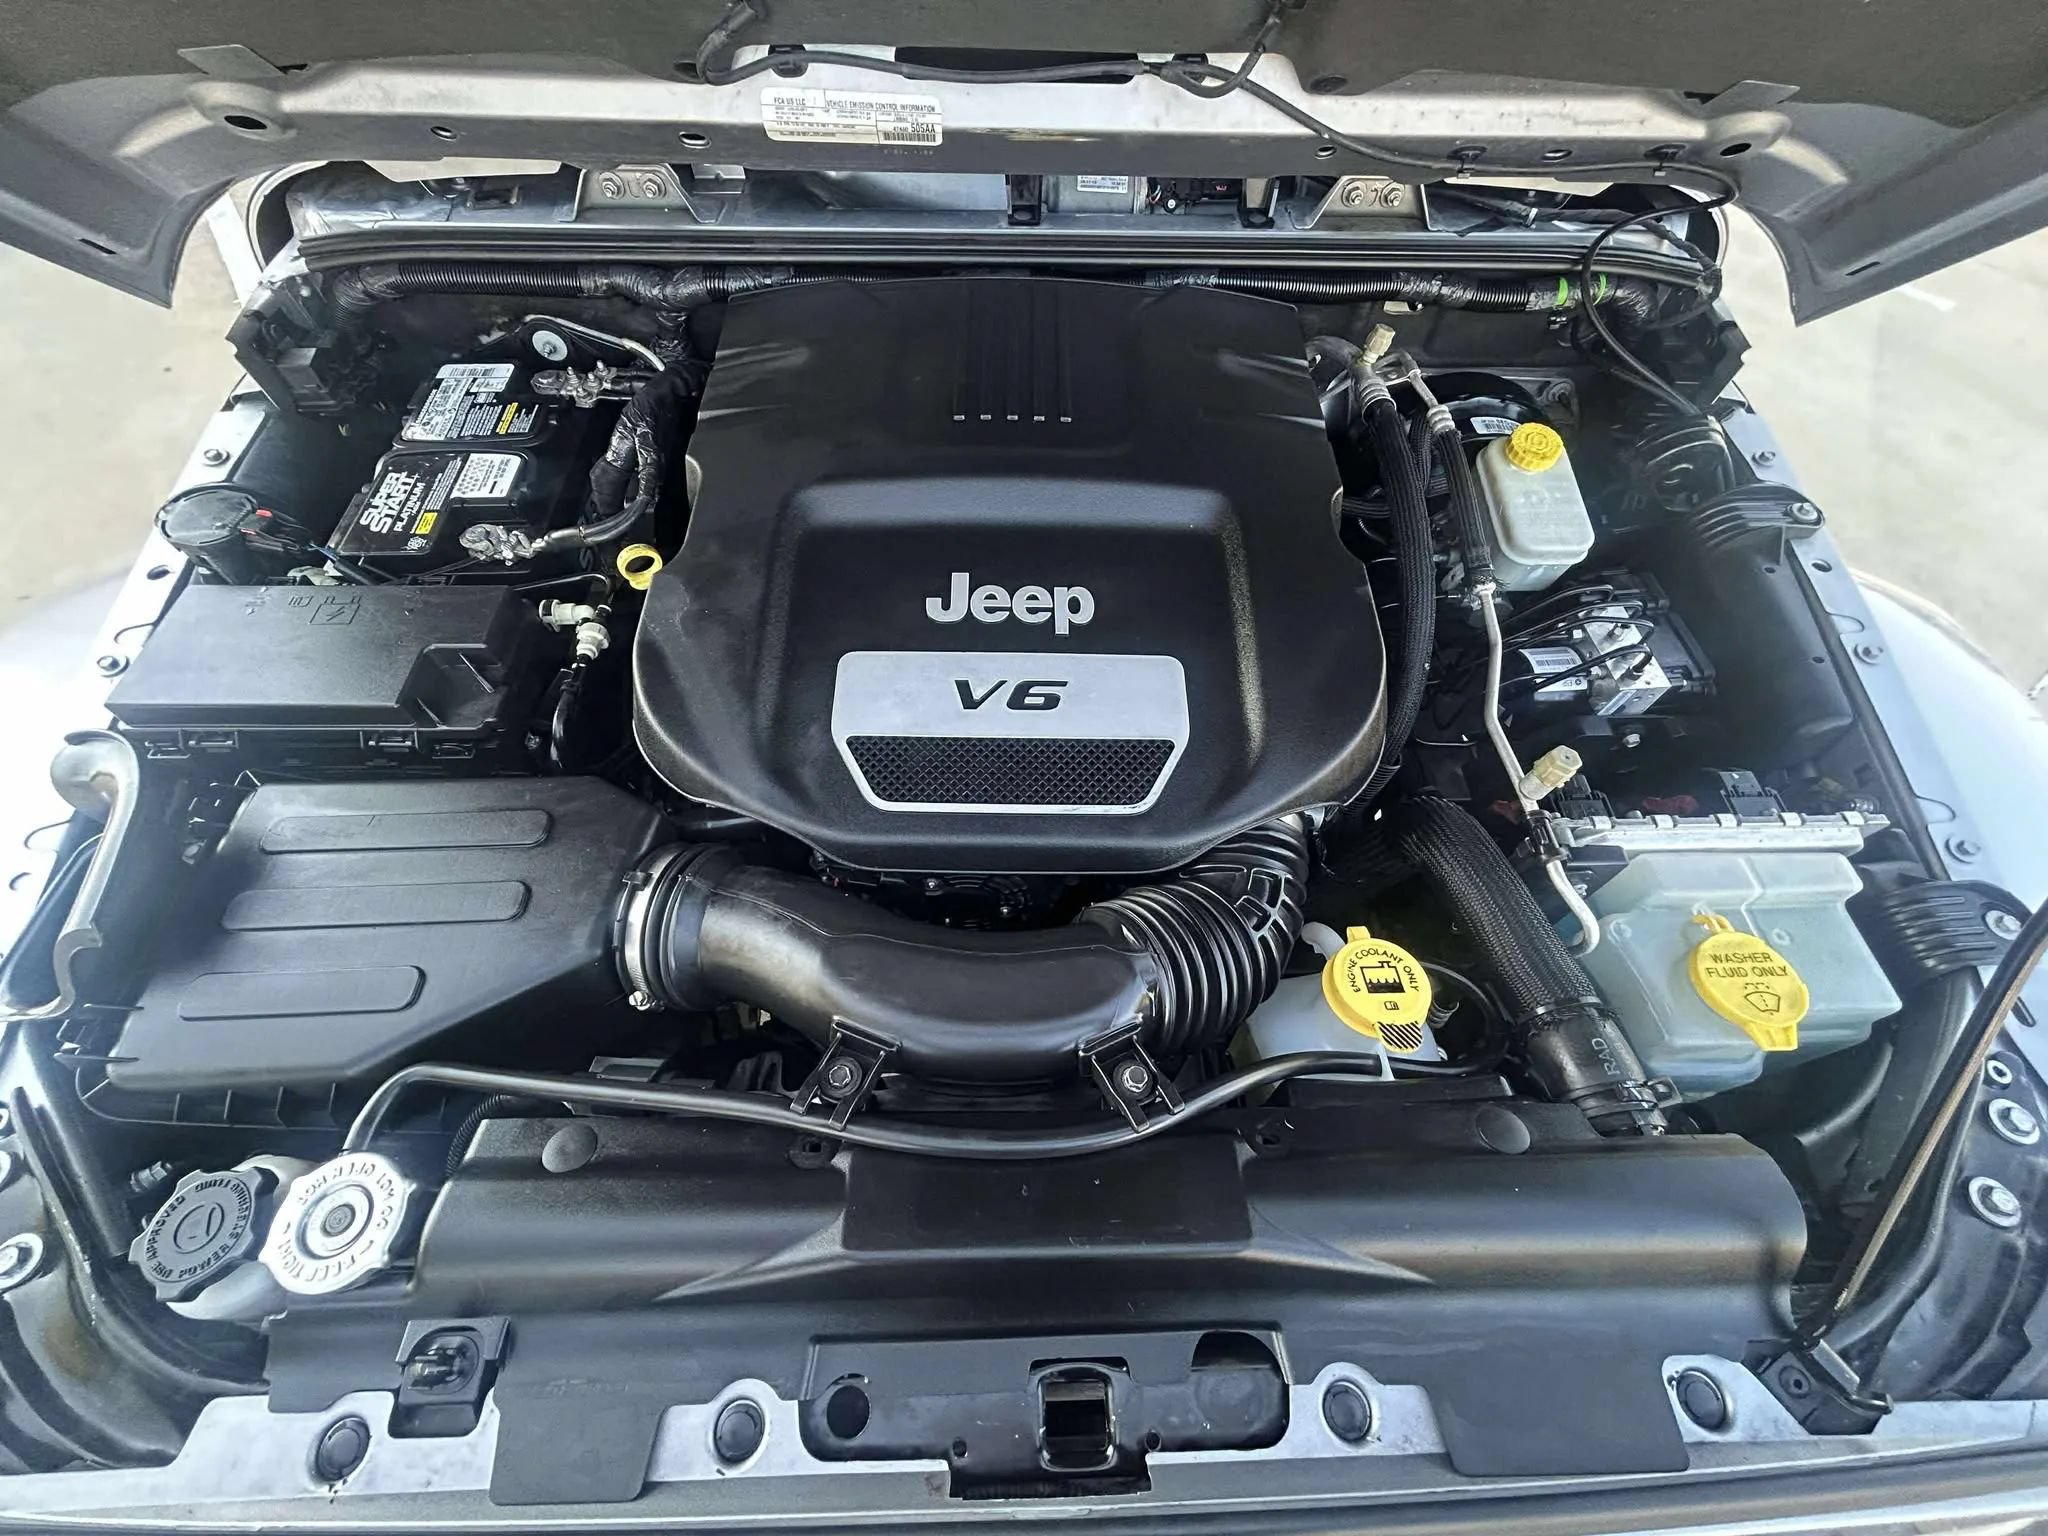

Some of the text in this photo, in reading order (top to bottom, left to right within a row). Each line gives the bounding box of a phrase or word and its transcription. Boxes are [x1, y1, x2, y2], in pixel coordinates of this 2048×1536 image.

[826, 100, 936, 112] VEHICLE EMISSION CONTROL INFORMATION
[911, 122, 936, 133] 505AA
[359, 471, 402, 526] SUPER
[370, 473, 414, 533] START
[394, 482, 426, 532] PLATINUM
[925, 571, 1095, 636] Jeep
[953, 678, 1070, 711] V6
[1347, 948, 1420, 993] ENGINE COOLANT ONLY
[1705, 966, 1789, 978] FLUID ONLY
[1708, 952, 1773, 965] WASHER
[1592, 1038, 1620, 1075] RAD
[146, 1195, 186, 1261] APPROVED
